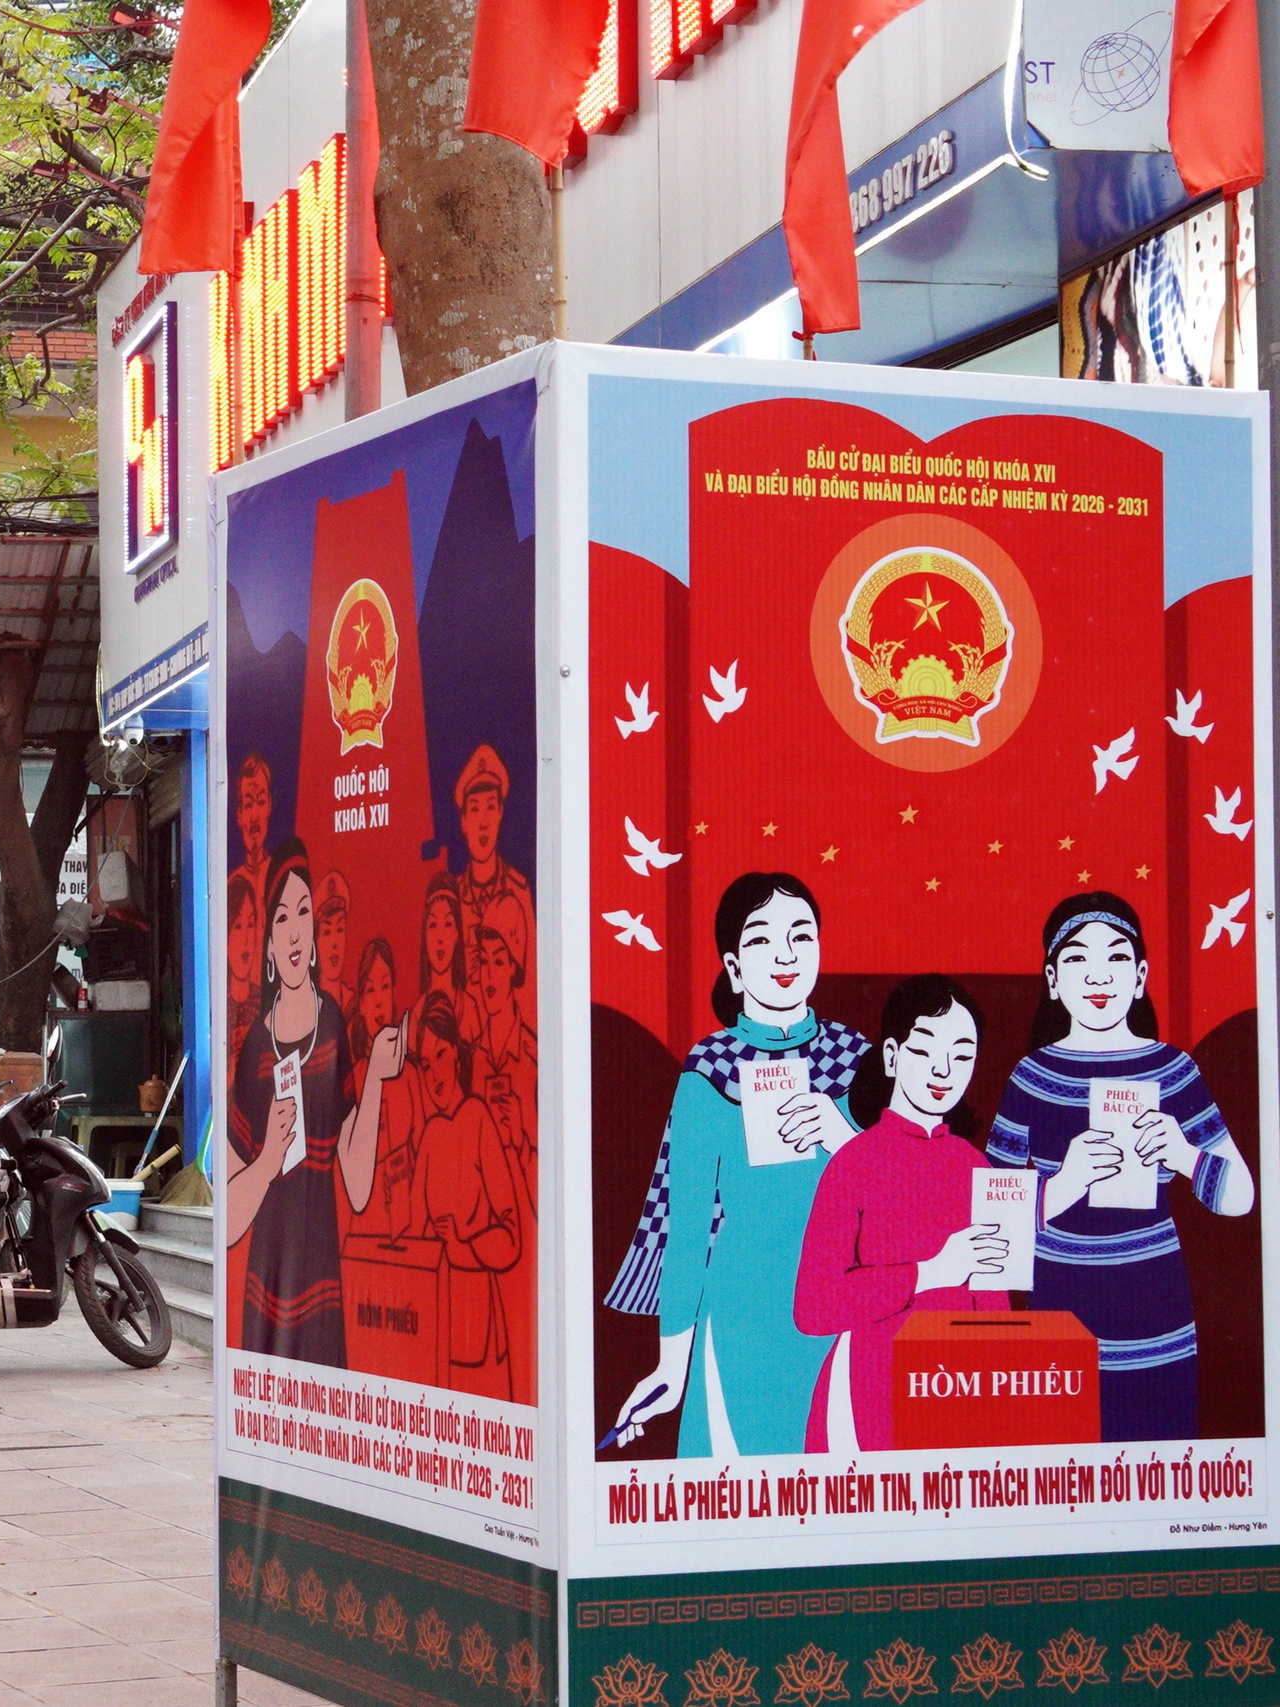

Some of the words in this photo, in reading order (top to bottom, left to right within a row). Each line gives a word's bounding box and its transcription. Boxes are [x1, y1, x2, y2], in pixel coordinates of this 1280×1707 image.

[882, 154, 915, 212] 997
[917, 130, 954, 190] 226
[209, 193, 290, 474] KNH
[807, 444, 835, 469] BẦU
[839, 445, 860, 471] CỬ
[862, 453, 886, 476] ĐẠI
[890, 448, 921, 475] BIỂU
[926, 452, 962, 479] QUỐC
[967, 456, 989, 482] HỘI
[994, 459, 1030, 482] KHÓA
[1034, 464, 1056, 483] XVI
[705, 470, 723, 492] VÀ
[728, 474, 751, 498] ĐẠI
[756, 469, 788, 495] BIỂU
[793, 473, 816, 501] HỘI
[820, 473, 859, 499] ĐỒNG
[863, 479, 902, 502] NHÂN
[907, 481, 935, 503] DÂN
[940, 482, 967, 505] CÁC
[971, 482, 998, 507] CẤP
[1003, 487, 1047, 514] NHIỆM
[1051, 489, 1068, 511] KỲ
[1072, 494, 1105, 514] 2026
[1117, 497, 1149, 516] 2031
[904, 705, 927, 716] VIỆT
[929, 706, 952, 717] NAM
[334, 765, 365, 801] QUỐC
[369, 763, 389, 797] HỘI
[334, 802, 366, 833] KHOÁ
[370, 803, 389, 829] XVI
[65, 861, 87, 873] THAY
[753, 1077, 777, 1092] BẦU
[778, 1077, 798, 1091] CỬ
[755, 1064, 791, 1079] PHIẾU
[1102, 1101, 1125, 1114] BẦU
[1127, 1102, 1145, 1114] CỬ
[1106, 1087, 1140, 1101] PHIẾU
[986, 1188, 1008, 1201] BẦU
[1009, 1188, 1028, 1201] CỬ
[989, 1175, 1023, 1188] PHIẾU
[357, 1298, 382, 1329] HÒM
[385, 1302, 419, 1336] PHIẾU
[908, 1363, 981, 1398] HÒM
[991, 1361, 1083, 1397] PHIẾU
[234, 1365, 256, 1404] NHIỆT
[259, 1368, 275, 1403] LIỆT
[277, 1372, 299, 1407] CHÀO
[301, 1376, 327, 1415] MỪNG
[329, 1382, 353, 1420] NGÀY
[355, 1383, 373, 1425] BẦU
[376, 1384, 390, 1429] CỬ
[390, 1401, 407, 1438] ĐẠI
[409, 1393, 431, 1436] BIỂU
[434, 1401, 461, 1445] QUỐC
[463, 1410, 481, 1455] HỘI
[484, 1416, 512, 1457] KHÓA
[515, 1425, 534, 1462] XVI
[234, 1403, 246, 1437] VÀ
[247, 1413, 261, 1447] ĐẠI
[263, 1405, 280, 1445] BIỂU
[283, 1415, 297, 1455] HỘI
[299, 1414, 322, 1454] ĐỒNG
[325, 1425, 349, 1463] NHÂN
[352, 1429, 371, 1468] DÂN
[373, 1438, 392, 1474] CÁC
[394, 1436, 413, 1480] CẤP
[416, 1448, 448, 1493] NHIỆM
[451, 1453, 464, 1492] KỲ
[467, 1463, 492, 1500] 2026
[502, 1471, 534, 1510] 2031!
[609, 1468, 647, 1524] MỖI
[654, 1473, 678, 1522] LÁ
[684, 1466, 741, 1520] PHIẾU
[748, 1470, 771, 1518] LÀ
[778, 1468, 818, 1524] MỘT
[825, 1461, 874, 1514] NIỀM
[881, 1473, 916, 1516] TIN,
[923, 1463, 963, 1518] MỘT
[970, 1461, 1028, 1507] TRÁCH
[1034, 1458, 1094, 1512] NHIỆM
[1100, 1450, 1131, 1502] ĐỐI
[1136, 1451, 1165, 1501] VỚI
[1171, 1447, 1193, 1499] TỔ
[1199, 1447, 1253, 1502] QUỐC!
[1183, 1524, 1199, 1533] Như
[1229, 1523, 1250, 1532] Hưng
[1252, 1521, 1267, 1530] Yên
